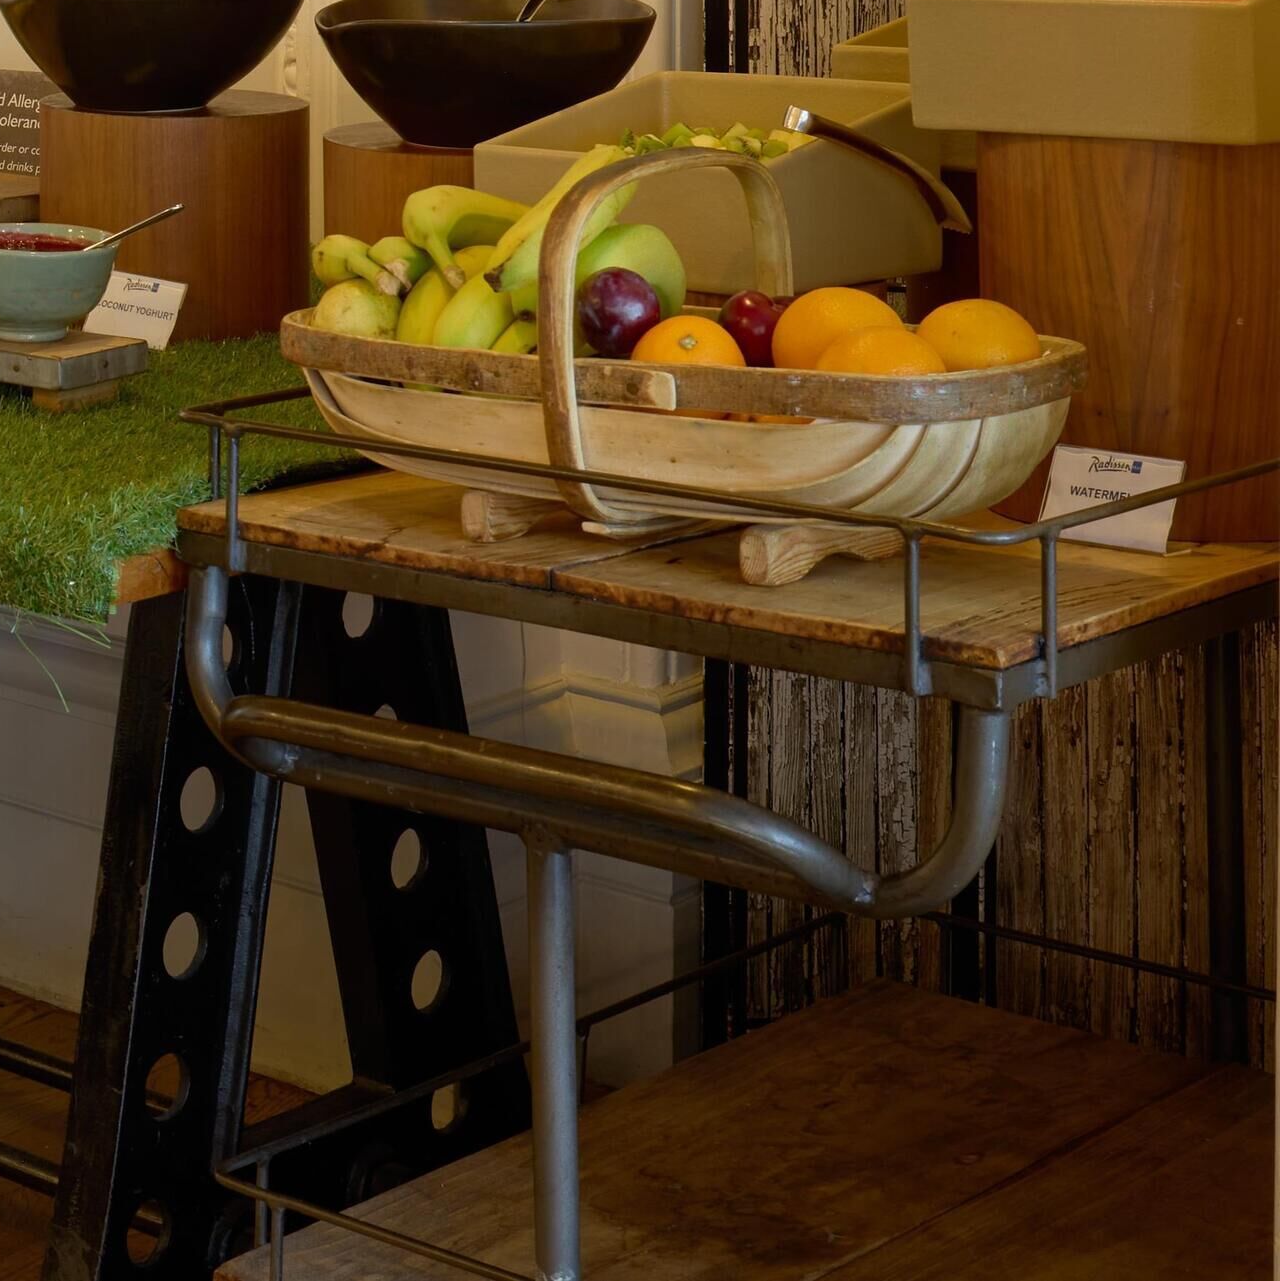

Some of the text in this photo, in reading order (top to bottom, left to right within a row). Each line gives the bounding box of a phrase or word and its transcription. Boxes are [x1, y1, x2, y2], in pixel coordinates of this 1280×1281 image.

[18, 146, 29, 155] or
[6, 160, 34, 173] drinks
[97, 299, 175, 321] OCONUT YOGHURT
[1088, 455, 1131, 473] Radisson
